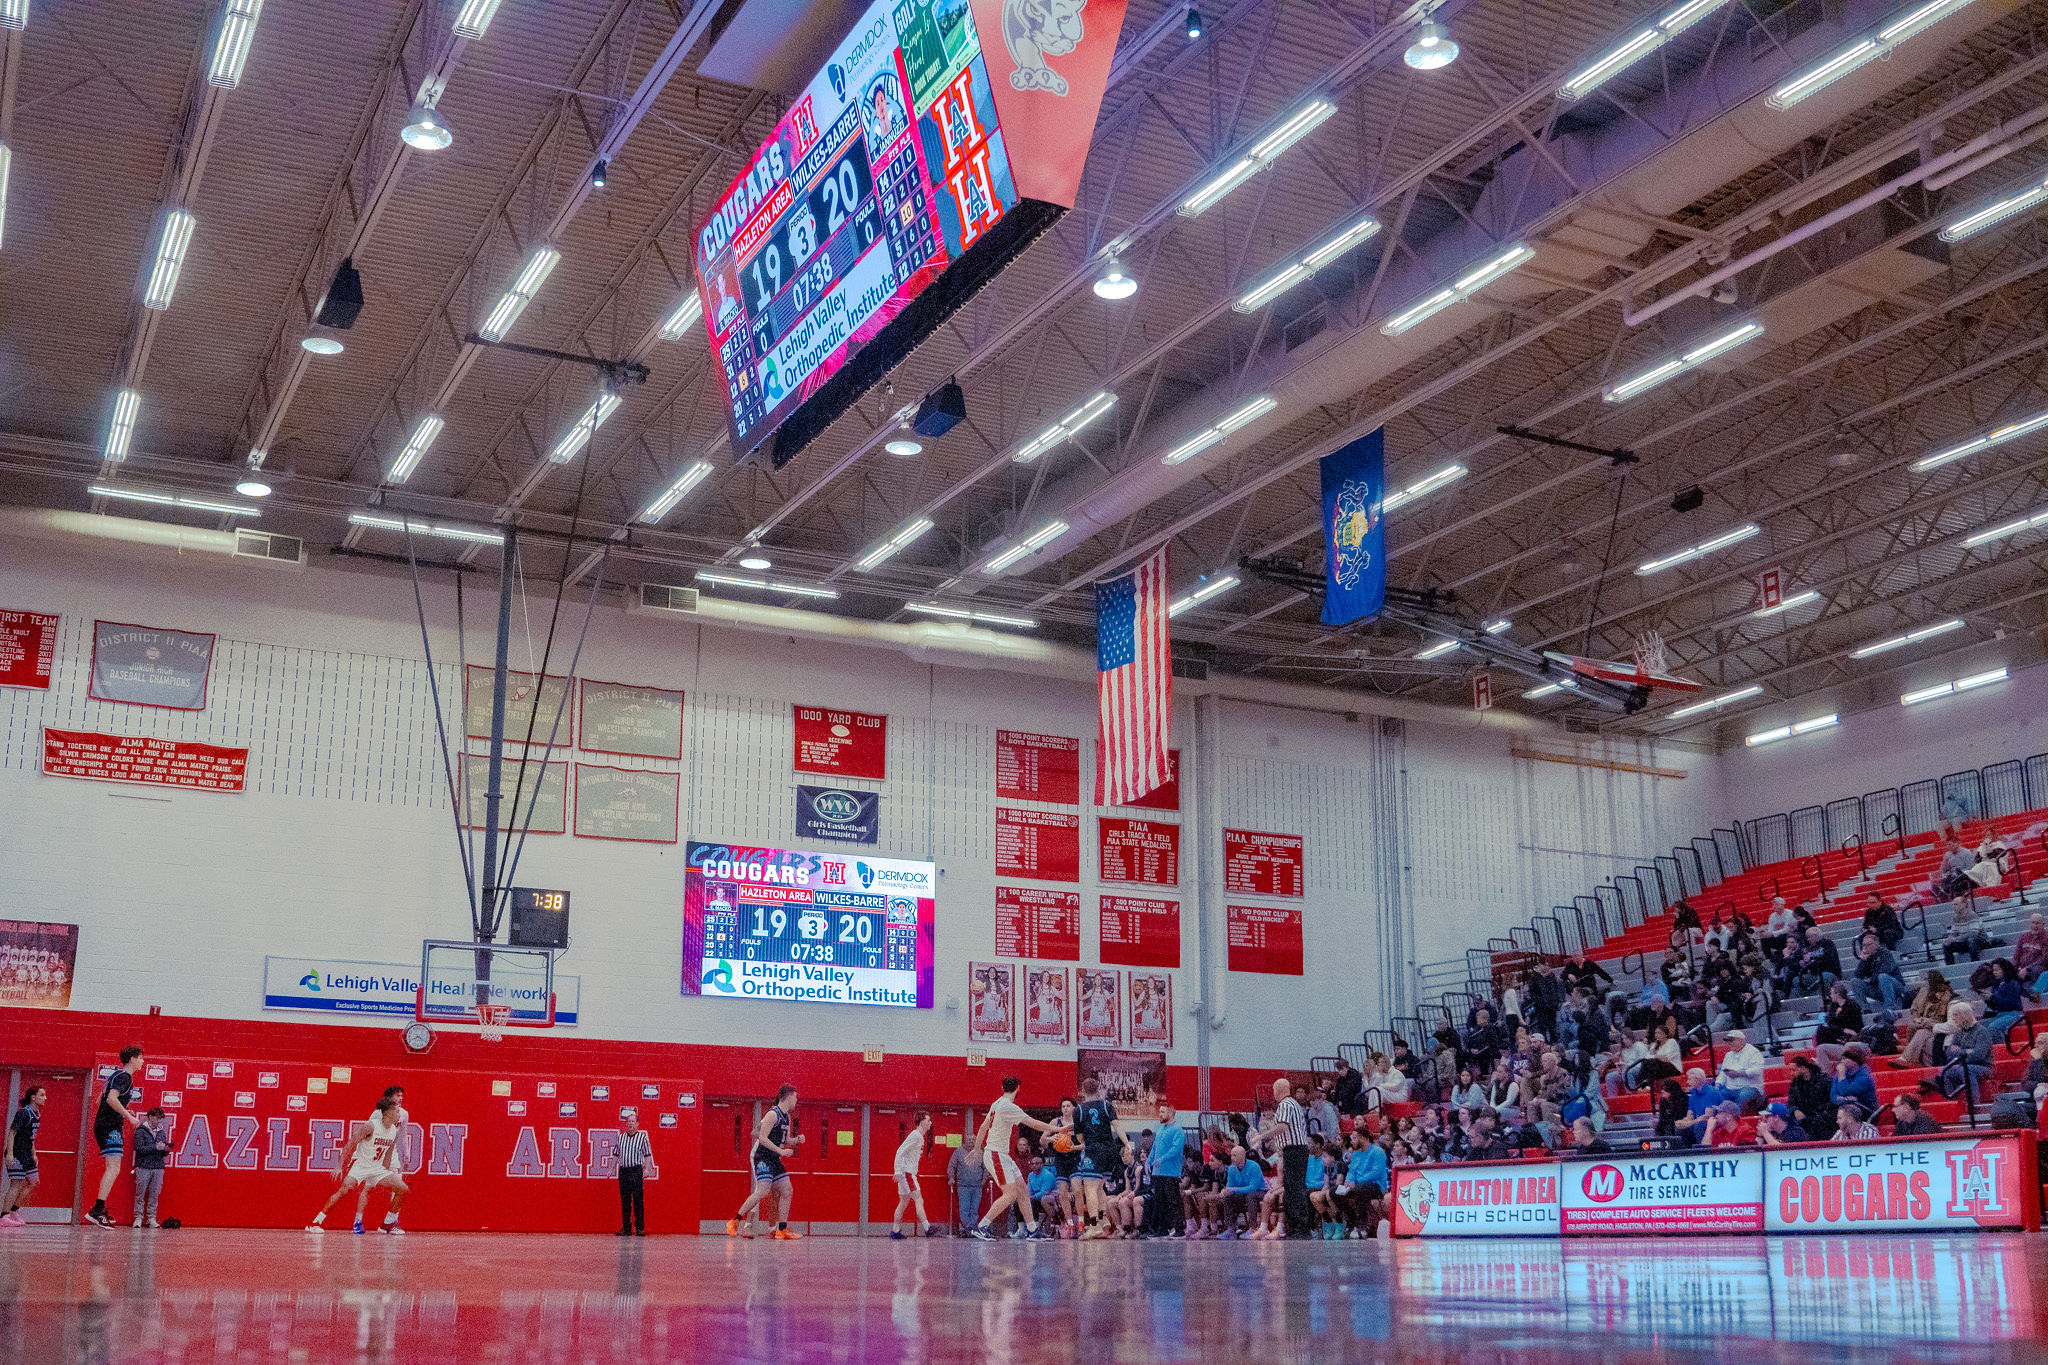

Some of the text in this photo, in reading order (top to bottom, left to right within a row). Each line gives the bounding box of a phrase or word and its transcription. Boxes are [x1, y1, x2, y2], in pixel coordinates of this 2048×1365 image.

[792, 104, 859, 192] WILKES-BARRE
[702, 141, 785, 262] COUGARS
[823, 159, 859, 236] 20
[790, 206, 809, 231] PERIOD
[855, 198, 875, 227] FOULS
[734, 187, 792, 260] HAZLETON AREA
[865, 221, 874, 244] 0
[800, 225, 809, 256] 3
[752, 244, 781, 313] 19
[792, 252, 833, 312] 07:38
[752, 312, 769, 335] FOULS
[779, 288, 847, 366] Lehigh Valley
[784, 271, 897, 388] Orthopedic Institute
[760, 332, 768, 353] 0
[30, 614, 57, 627] TEAM
[100, 632, 160, 648] DISTRICT
[181, 640, 209, 659] PIAA
[110, 669, 146, 683] BASEBALL
[149, 673, 191, 687] CHAMPIONS
[800, 709, 881, 728] 1000 YARD CLUB
[46, 740, 64, 748] STAND
[67, 742, 97, 751] TOGETHER
[143, 749, 160, 757] PRIDE
[121, 739, 176, 751] ALMA MATER
[53, 765, 70, 773] RAISE
[88, 768, 108, 776] VOICES
[198, 779, 217, 787] MATER
[1022, 811, 1040, 819] POINT
[1028, 818, 1068, 828] BASKETBALL
[817, 828, 858, 839] Champion
[1127, 830, 1145, 840] TRACK
[1154, 833, 1170, 842] FIELD
[1128, 821, 1149, 832] PIAA
[1121, 838, 1140, 847] STATE
[1140, 840, 1172, 850] MEDALISTS
[1251, 834, 1302, 849] CHAMPIONSHIPS
[702, 859, 810, 885] COUGARS
[532, 893, 563, 910] 7:38
[740, 887, 812, 902] HAZLETON AREA
[815, 893, 885, 907] WILKES-BARRE
[1019, 895, 1056, 905] WRESTLING
[1021, 889, 1047, 898] CAREER
[752, 907, 787, 938] 19
[1252, 909, 1272, 917] POINT
[1272, 910, 1290, 918] CLUB
[808, 920, 818, 936] 3
[838, 914, 872, 944] 20
[741, 938, 762, 946] FOULS
[747, 947, 754, 959] 0
[790, 943, 834, 962] 07:38
[869, 955, 876, 967] 0
[326, 973, 379, 993] Lehigh
[382, 976, 419, 992] Valle
[742, 961, 854, 986] Lehigh Valley
[742, 980, 917, 1004] Orthopedic Institute
[335, 1001, 360, 1009] Exclusive
[360, 1003, 379, 1011] Sports
[379, 1004, 403, 1012] Medicine
[1088, 1108, 1099, 1125] 2
[1629, 1159, 1739, 1182] McCARTHY
[1780, 1151, 1930, 1171] HOME OF THE
[1438, 1176, 1557, 1207] HAZLETON AREA
[1588, 1170, 1616, 1197] M
[1629, 1184, 1707, 1200] TIRE SERVICE
[1779, 1170, 1931, 1223] COUGARS
[1437, 1208, 1557, 1223] HIGH SCHOOL
[1567, 1206, 1757, 1220] TIRES COMPLETE AUTO SERVICE FLEETS WELCOME
